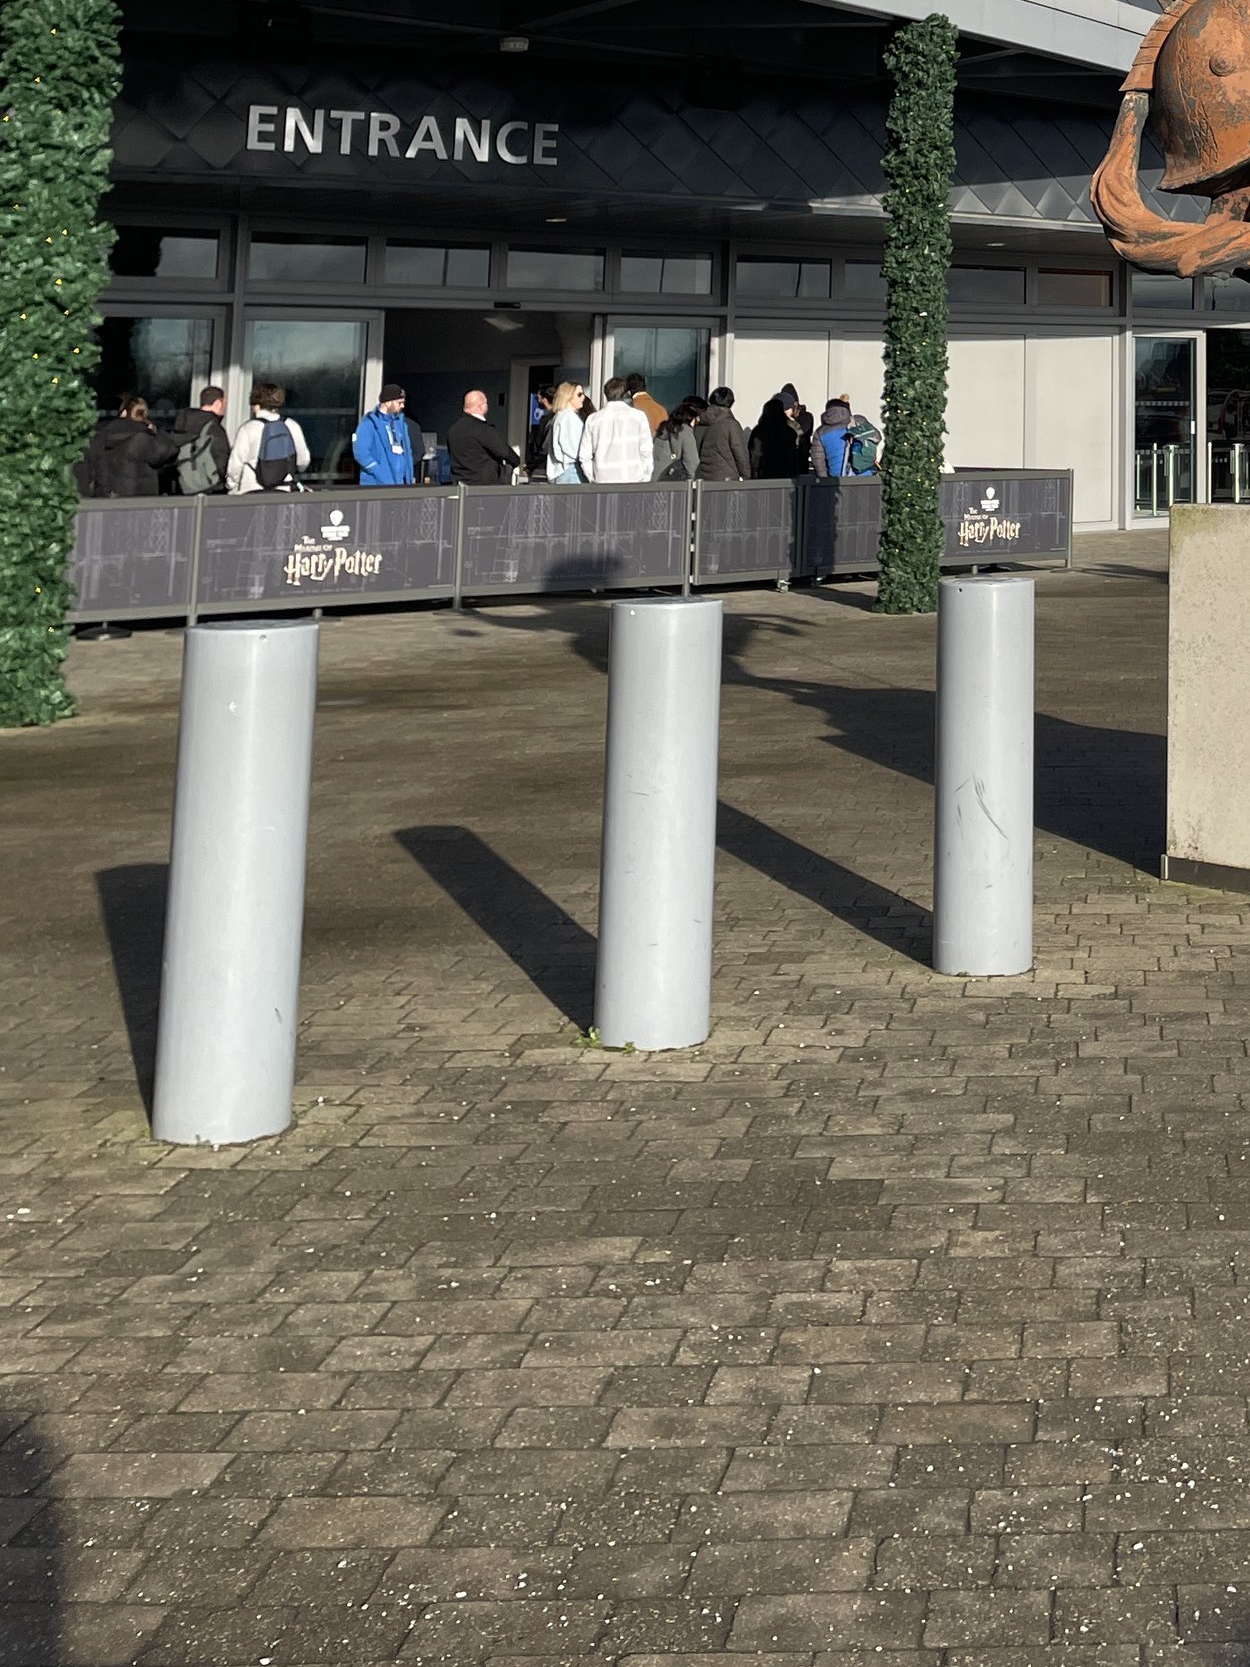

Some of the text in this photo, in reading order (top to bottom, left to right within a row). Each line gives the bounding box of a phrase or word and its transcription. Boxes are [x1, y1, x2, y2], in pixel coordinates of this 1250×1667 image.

[246, 104, 559, 166] ENTRANCE
[957, 517, 1021, 547] Harry Potter
[283, 547, 383, 587] Harry Potter
